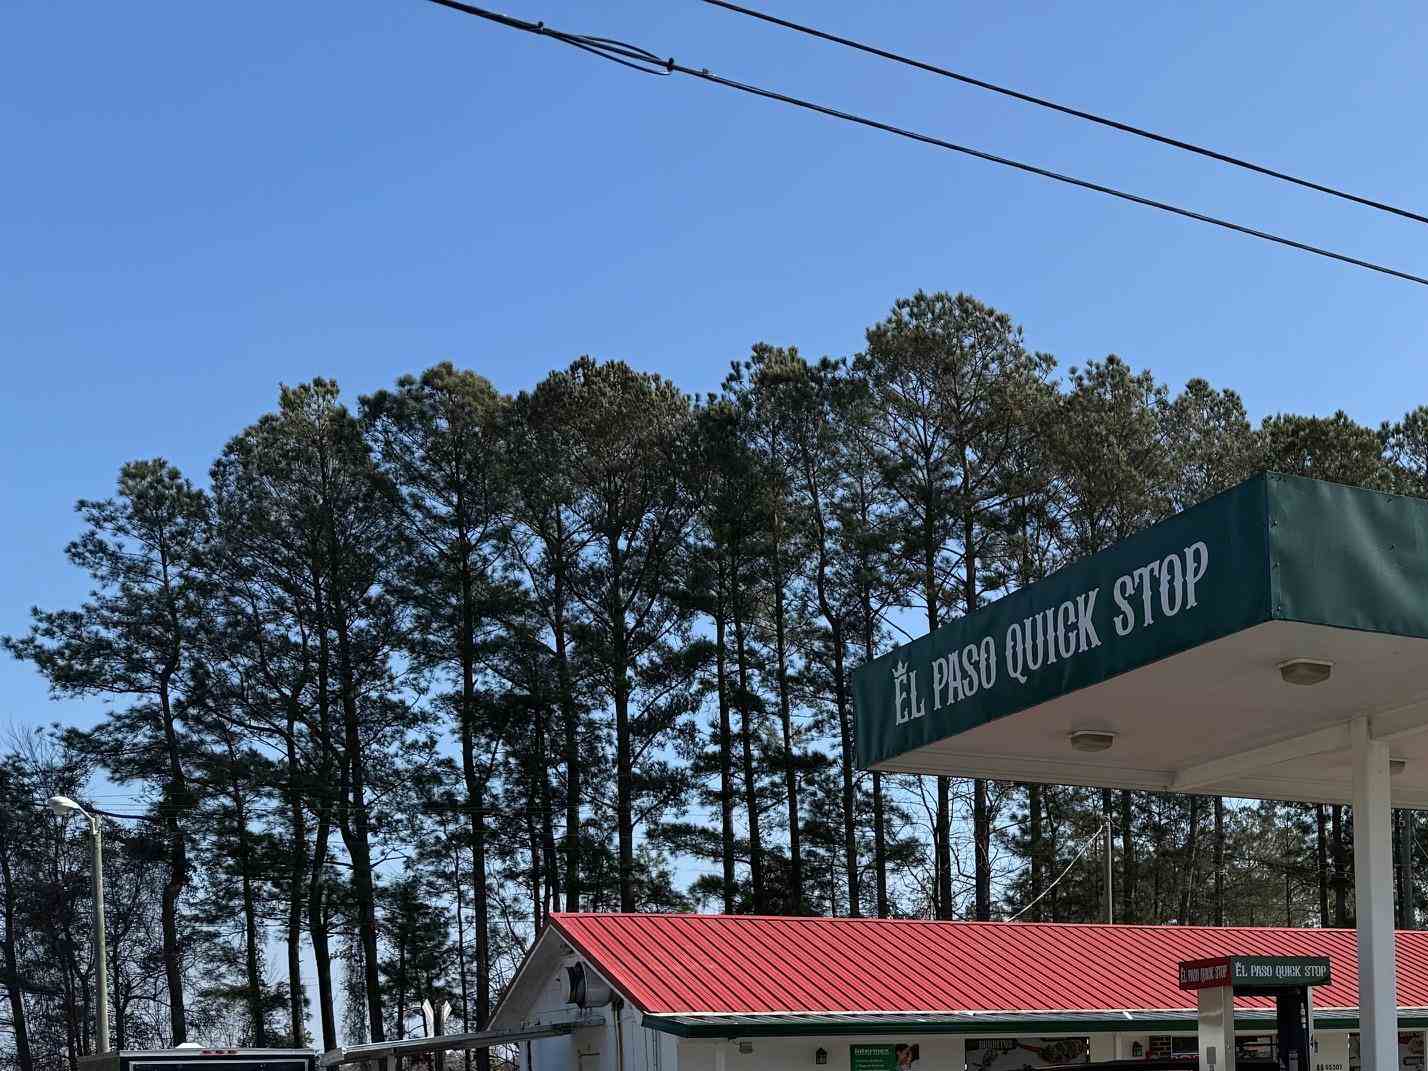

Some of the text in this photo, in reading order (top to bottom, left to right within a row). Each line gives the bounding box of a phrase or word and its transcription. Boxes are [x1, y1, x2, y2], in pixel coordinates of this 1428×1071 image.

[894, 540, 1210, 726] EL PASO QUICK STOP
[1188, 967, 1200, 983] PASO
[1200, 966, 1215, 983] QUICK
[1215, 965, 1228, 979] STOP
[1235, 965, 1327, 979] EL PASO QUICK STOP
